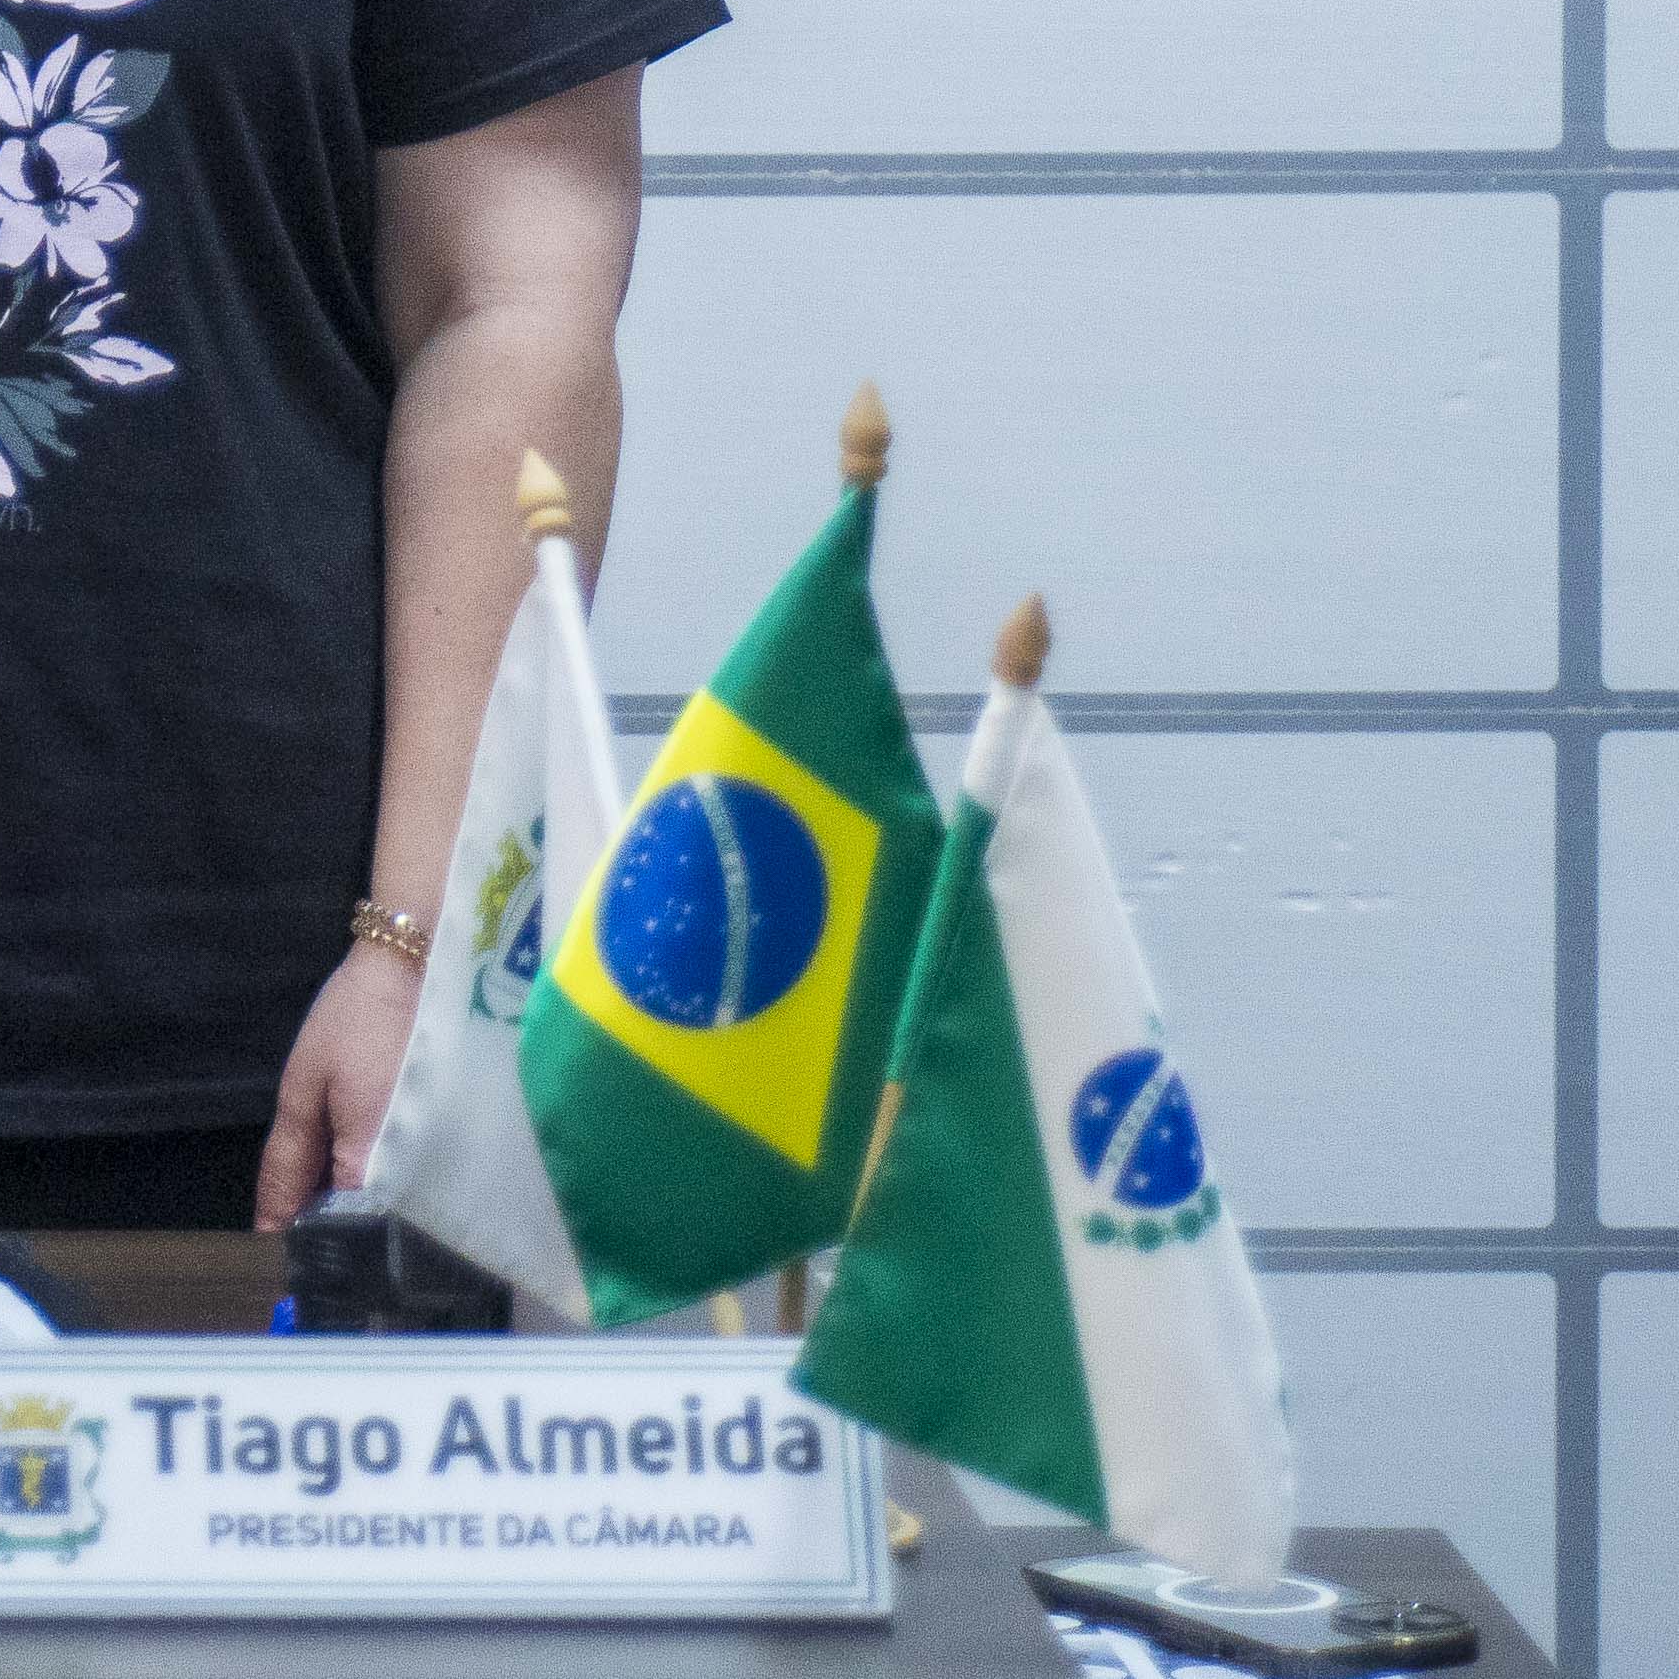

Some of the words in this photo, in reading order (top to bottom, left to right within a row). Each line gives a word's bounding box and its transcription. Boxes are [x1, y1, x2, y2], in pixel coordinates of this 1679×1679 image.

[131, 1395, 404, 1496] Tiago
[428, 1395, 824, 1477] Almeida
[208, 1513, 489, 1551] PRESIDENTE
[496, 1513, 556, 1551] DA
[564, 1508, 753, 1550] CÂMARA
